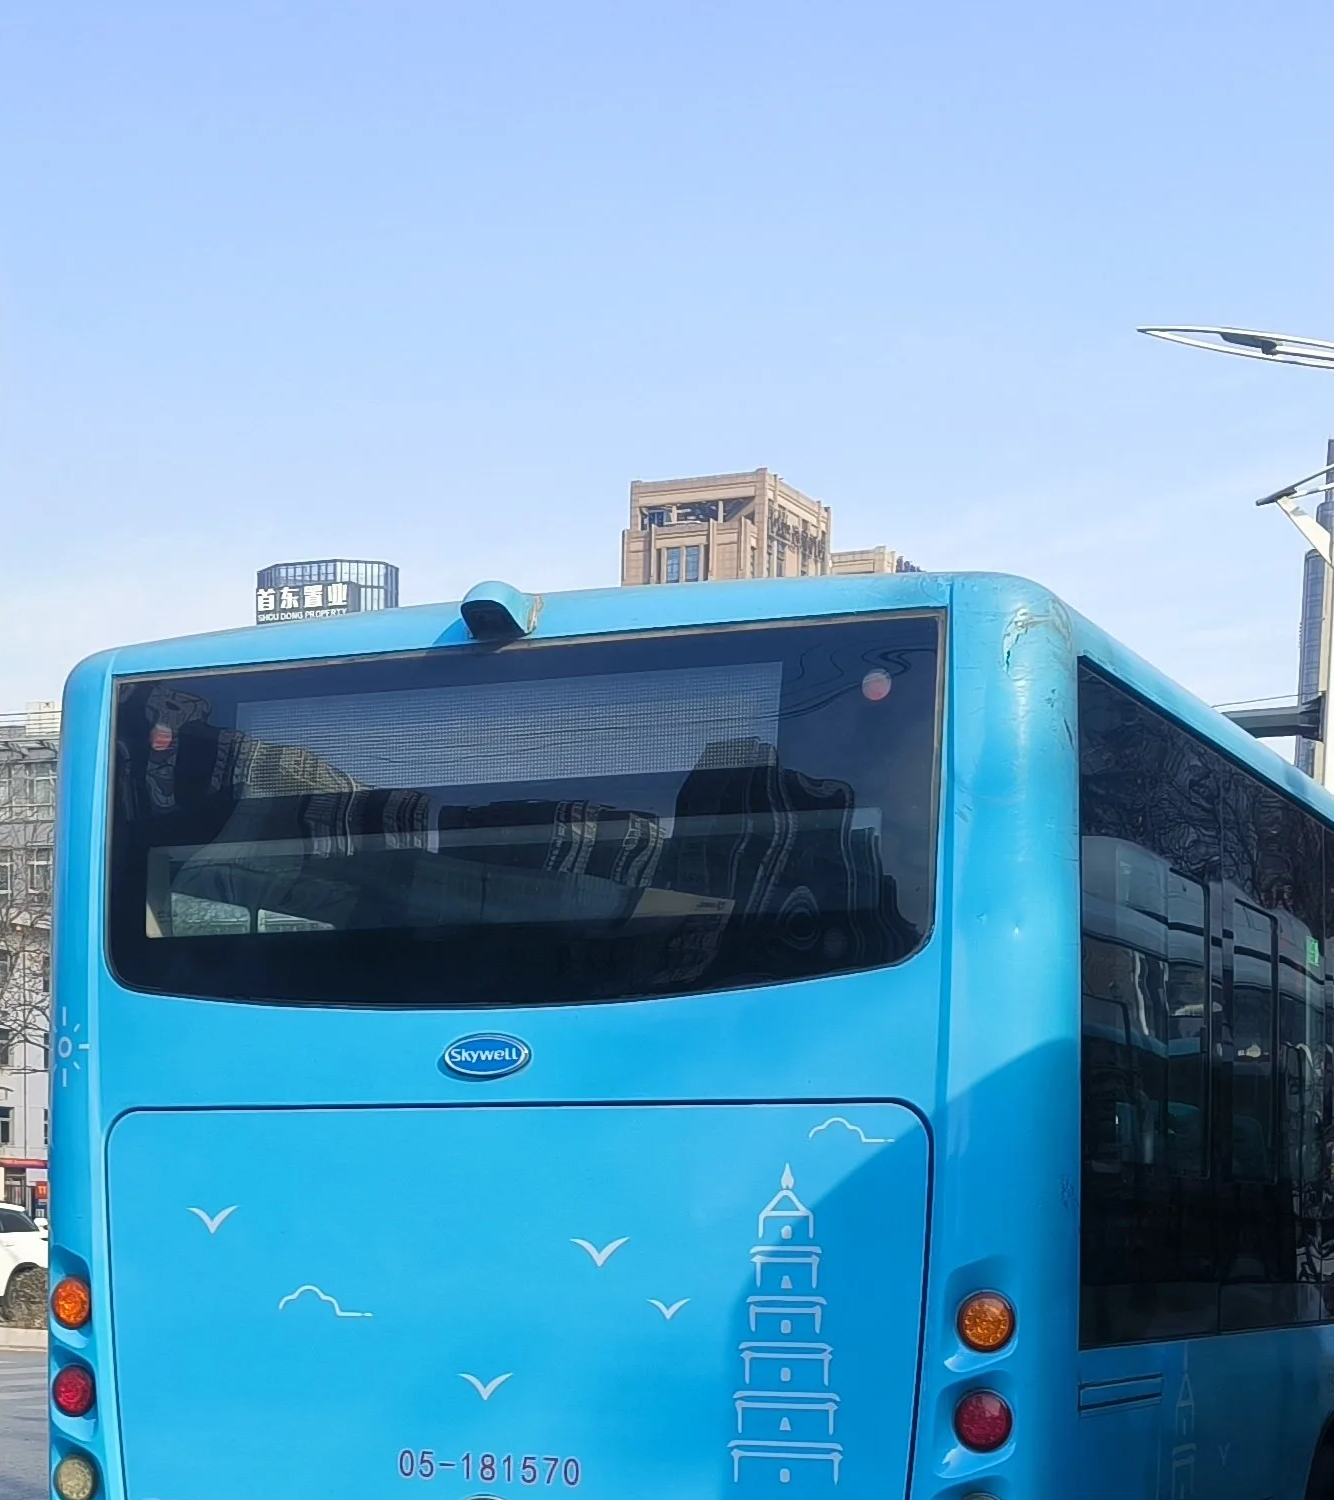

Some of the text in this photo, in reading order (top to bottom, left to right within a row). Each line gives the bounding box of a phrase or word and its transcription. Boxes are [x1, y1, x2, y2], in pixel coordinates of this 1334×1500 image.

[256, 582, 348, 612] 首东置业
[258, 607, 348, 622] SHOU DONG PROPERTY
[450, 1047, 519, 1063] Skywell
[398, 1449, 581, 1486] 05-181570
